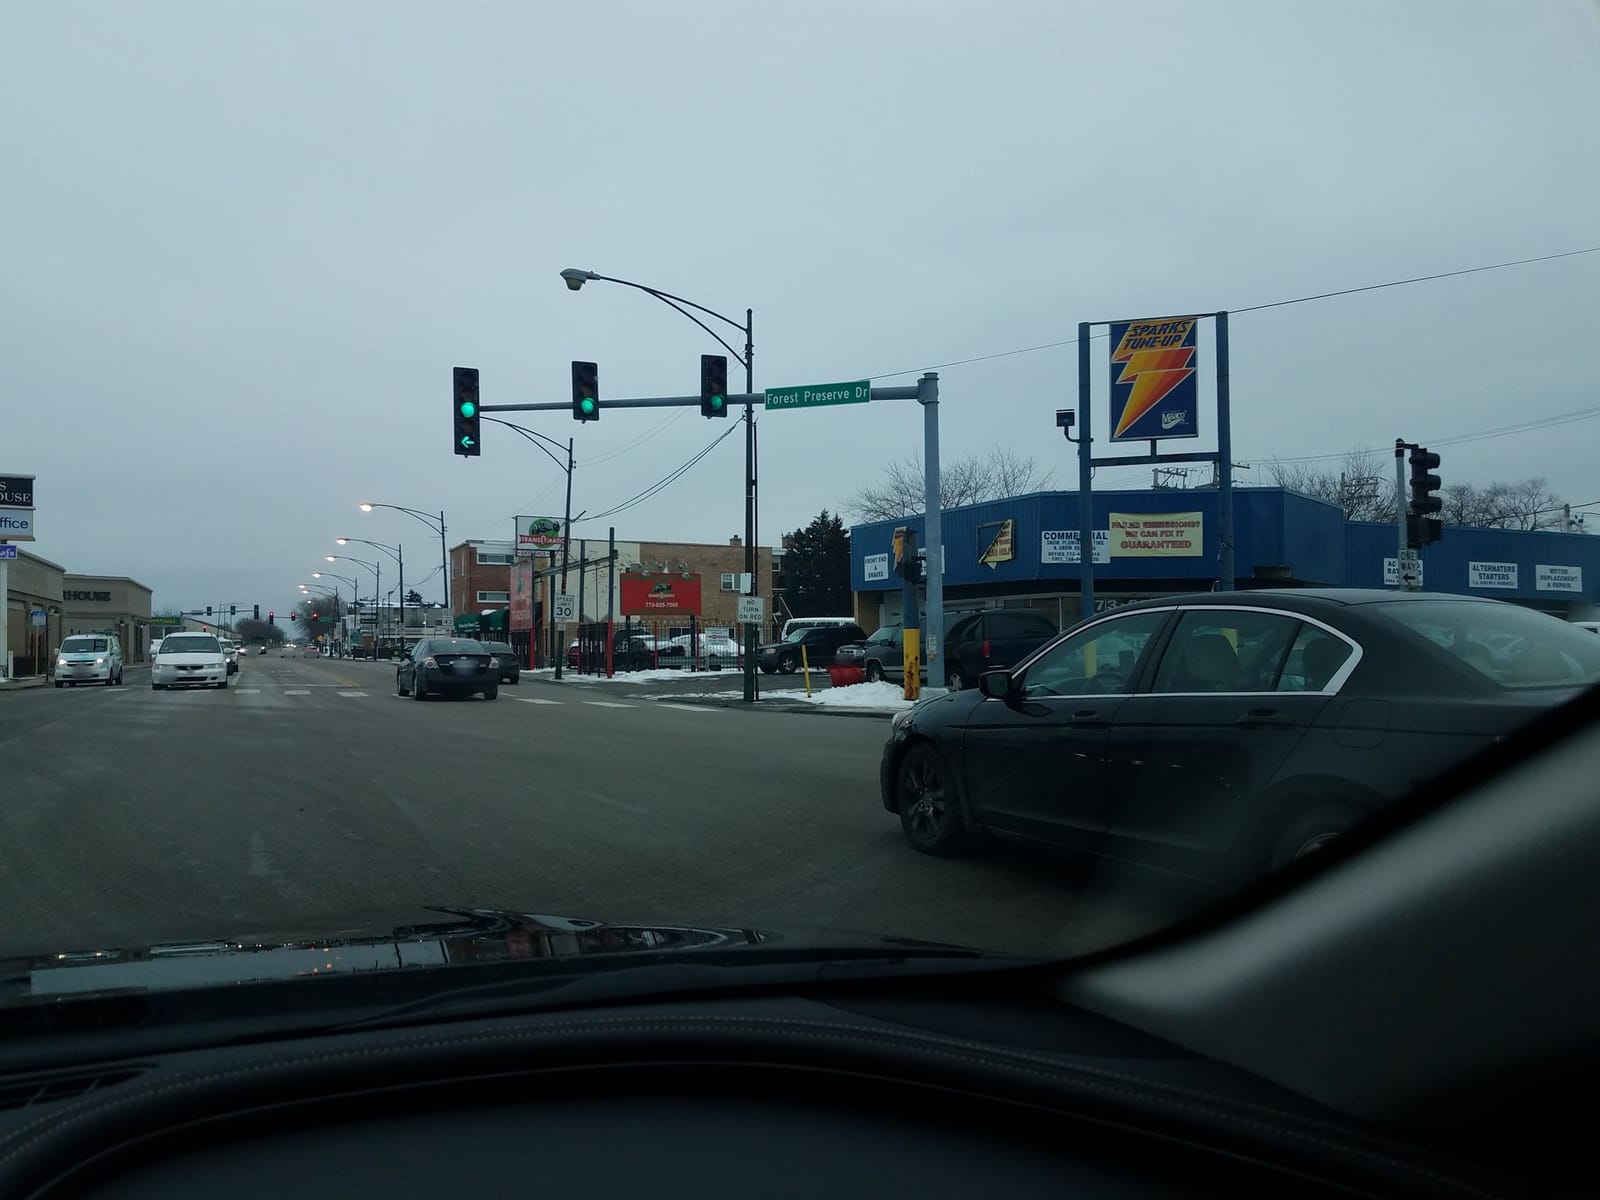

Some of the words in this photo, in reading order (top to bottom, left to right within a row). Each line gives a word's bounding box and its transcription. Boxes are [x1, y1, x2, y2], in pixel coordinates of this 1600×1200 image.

[1128, 321, 1190, 337] SPARKS
[1123, 334, 1182, 350] TUNE-UP
[767, 392, 799, 405] Forest
[804, 389, 850, 402] Preserve
[855, 386, 868, 398] Dr
[1044, 532, 1108, 540] COMMEIAL
[1120, 540, 1192, 549] GUARANTEED
[1400, 551, 1416, 561] ONE
[1478, 573, 1509, 581] STARTERS
[556, 607, 572, 617] 30
